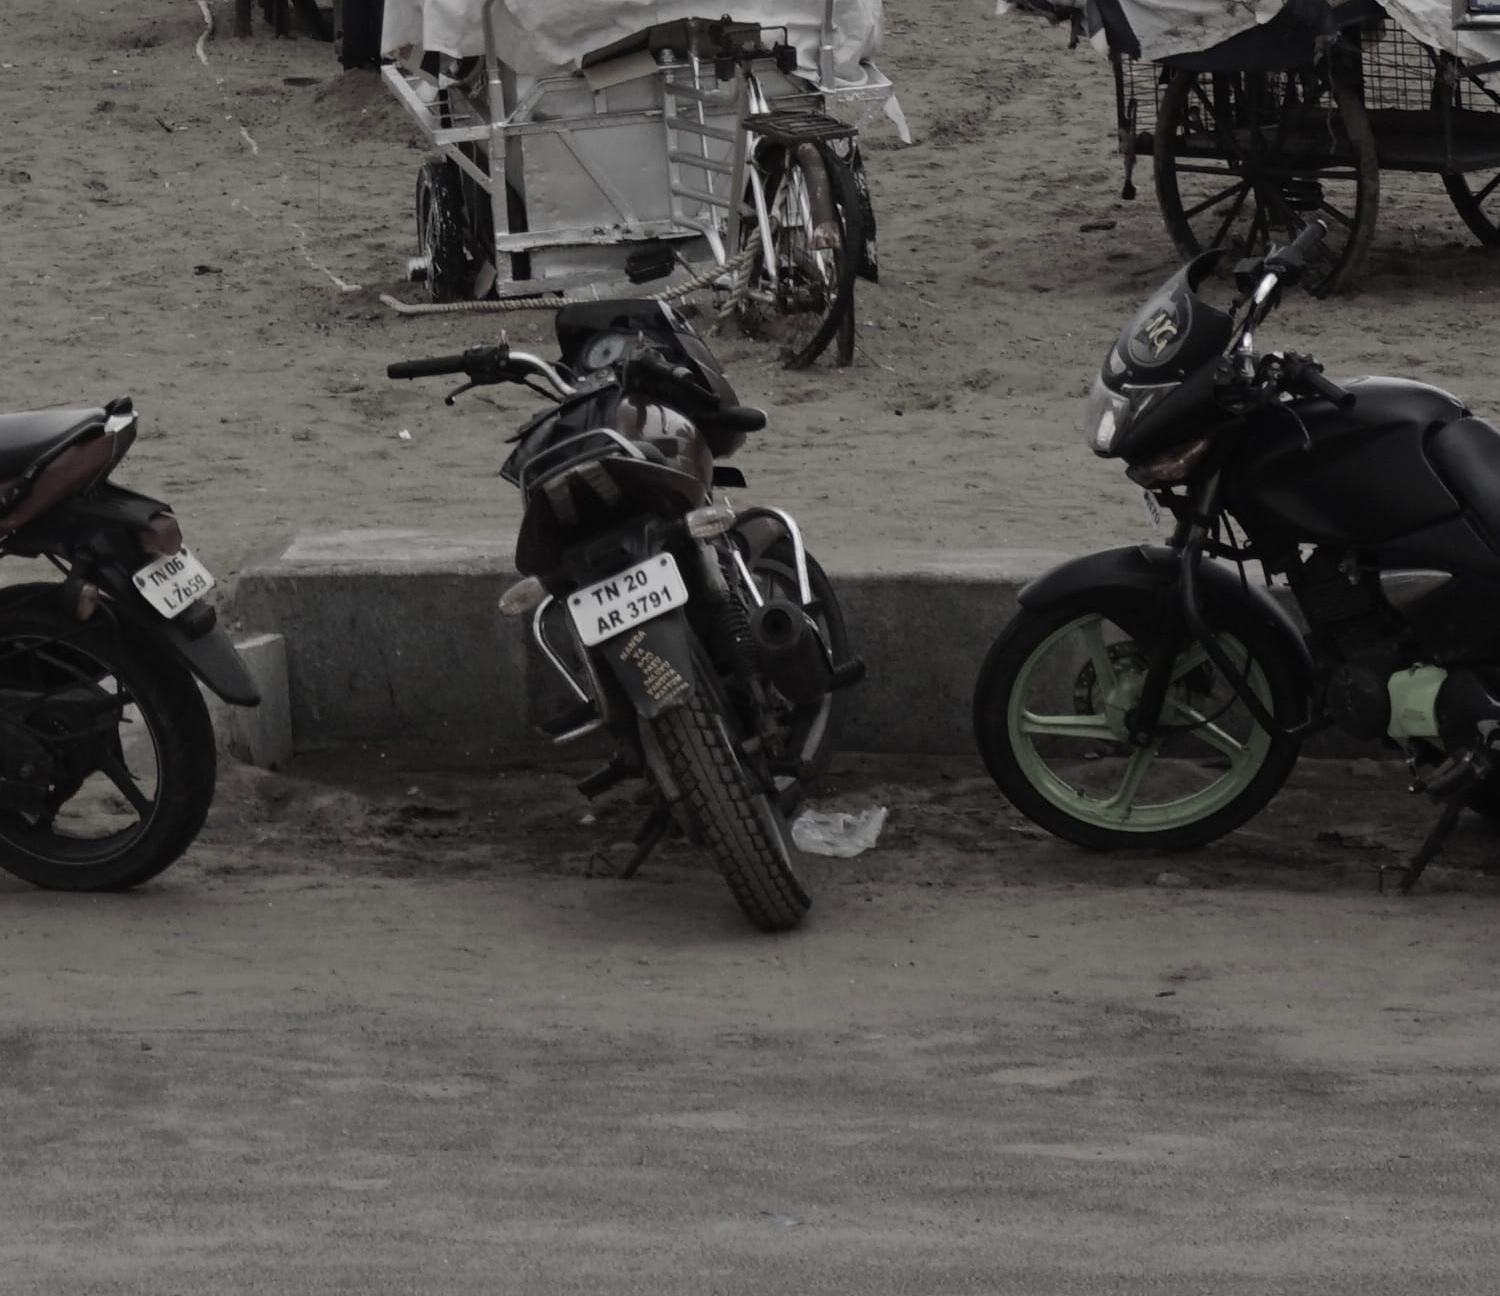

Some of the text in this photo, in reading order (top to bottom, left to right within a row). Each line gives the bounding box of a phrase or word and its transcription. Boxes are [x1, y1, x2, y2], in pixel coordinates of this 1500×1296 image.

[148, 557, 184, 587] TN 06
[592, 570, 648, 605] TN 20
[597, 586, 673, 634] AR 3791
